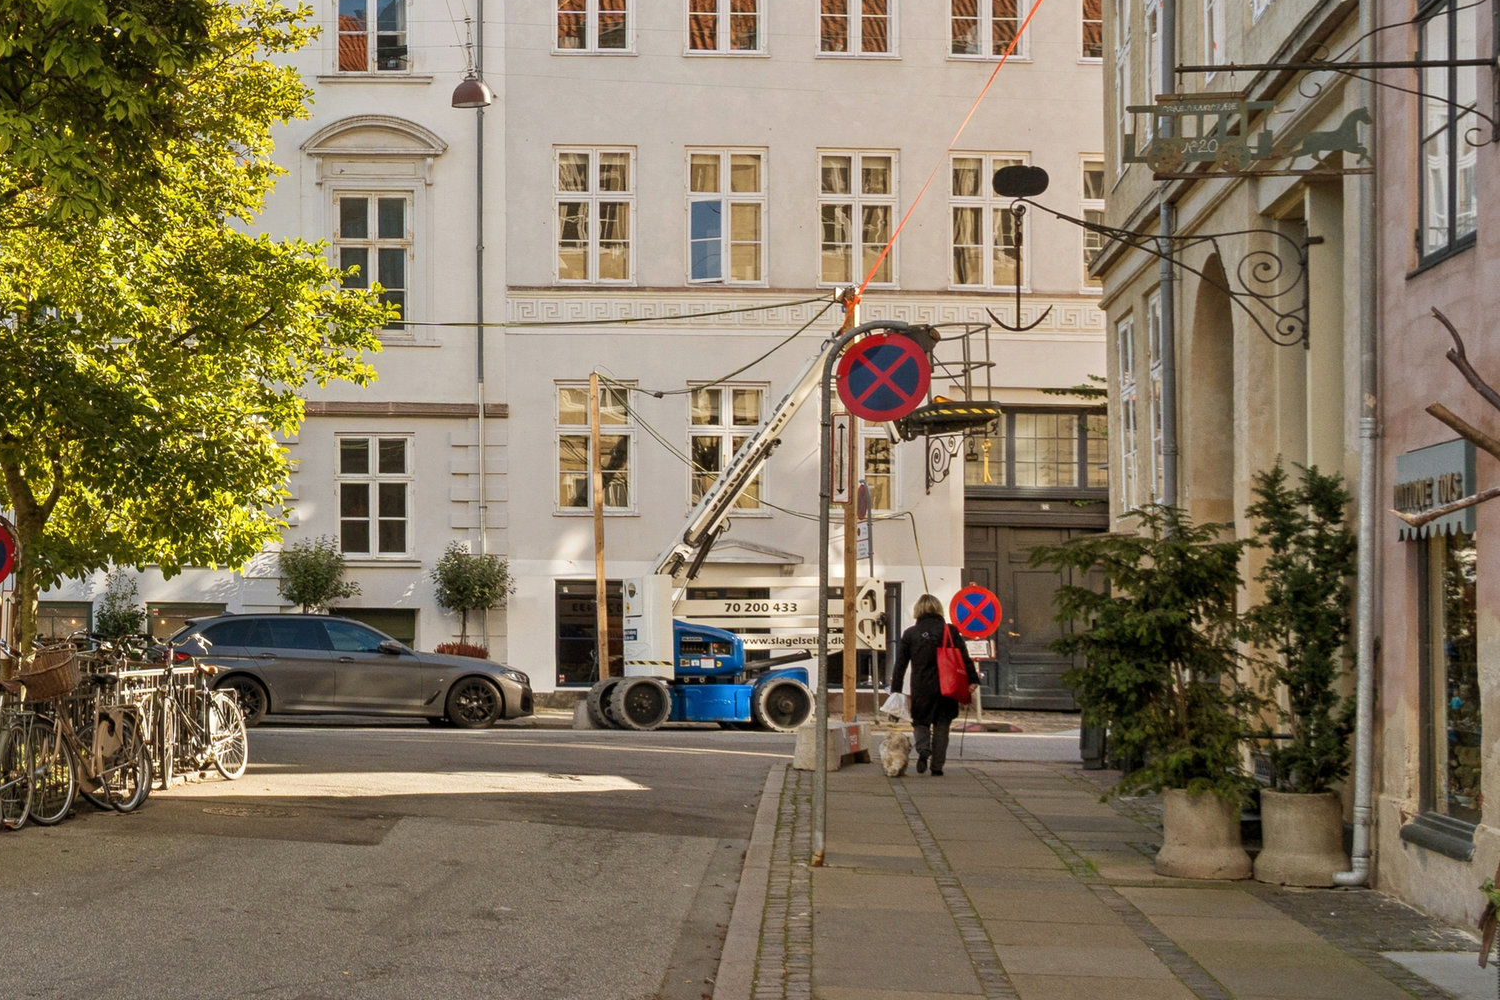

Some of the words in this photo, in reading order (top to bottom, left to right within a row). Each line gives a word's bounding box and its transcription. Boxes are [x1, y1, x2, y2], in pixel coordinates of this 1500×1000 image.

[724, 602, 741, 613] 70
[744, 602, 769, 613] 200
[773, 602, 798, 613] 433
[742, 636, 845, 647] www.slagelseli.dk
